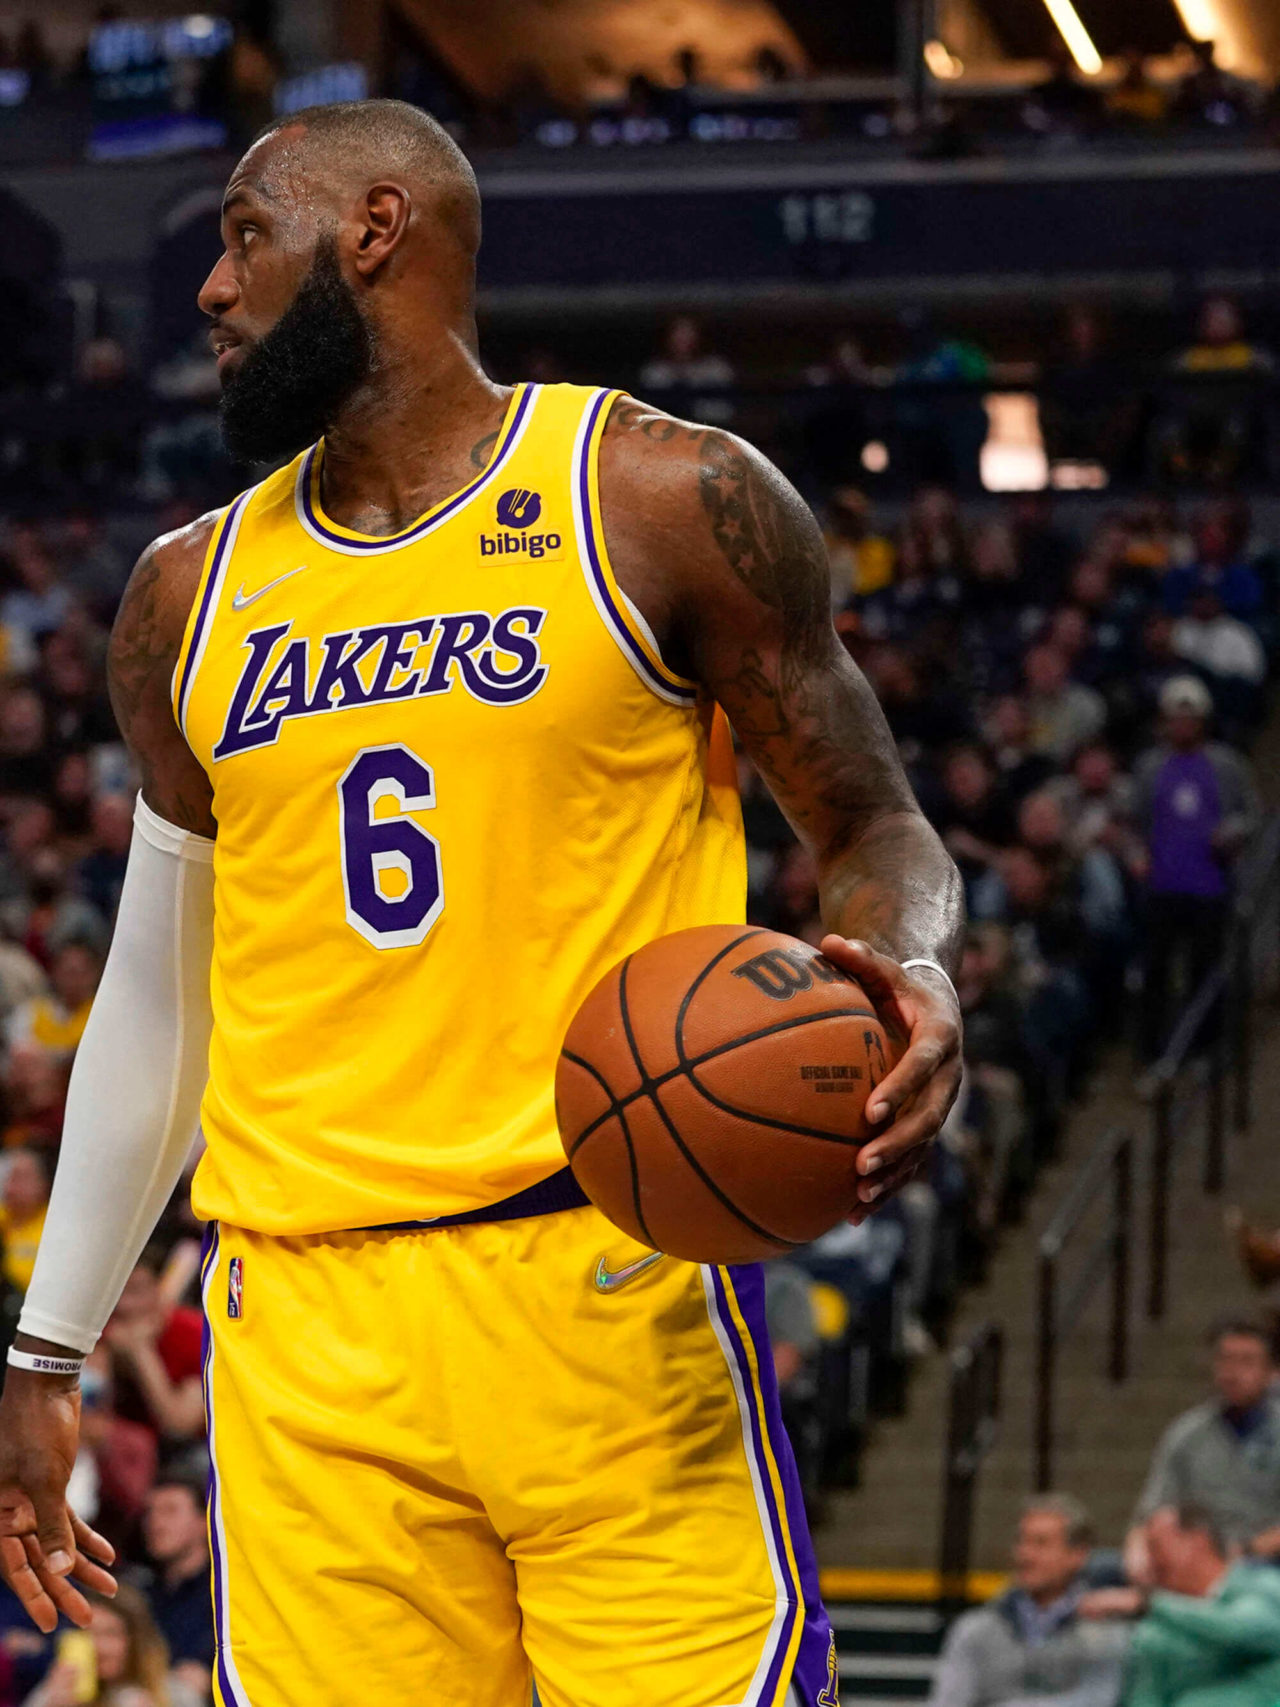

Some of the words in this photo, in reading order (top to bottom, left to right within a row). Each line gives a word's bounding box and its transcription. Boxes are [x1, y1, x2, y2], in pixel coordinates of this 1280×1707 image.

[480, 531, 561, 558] bibigo
[212, 605, 550, 763] LAKERS
[336, 742, 445, 950] 6
